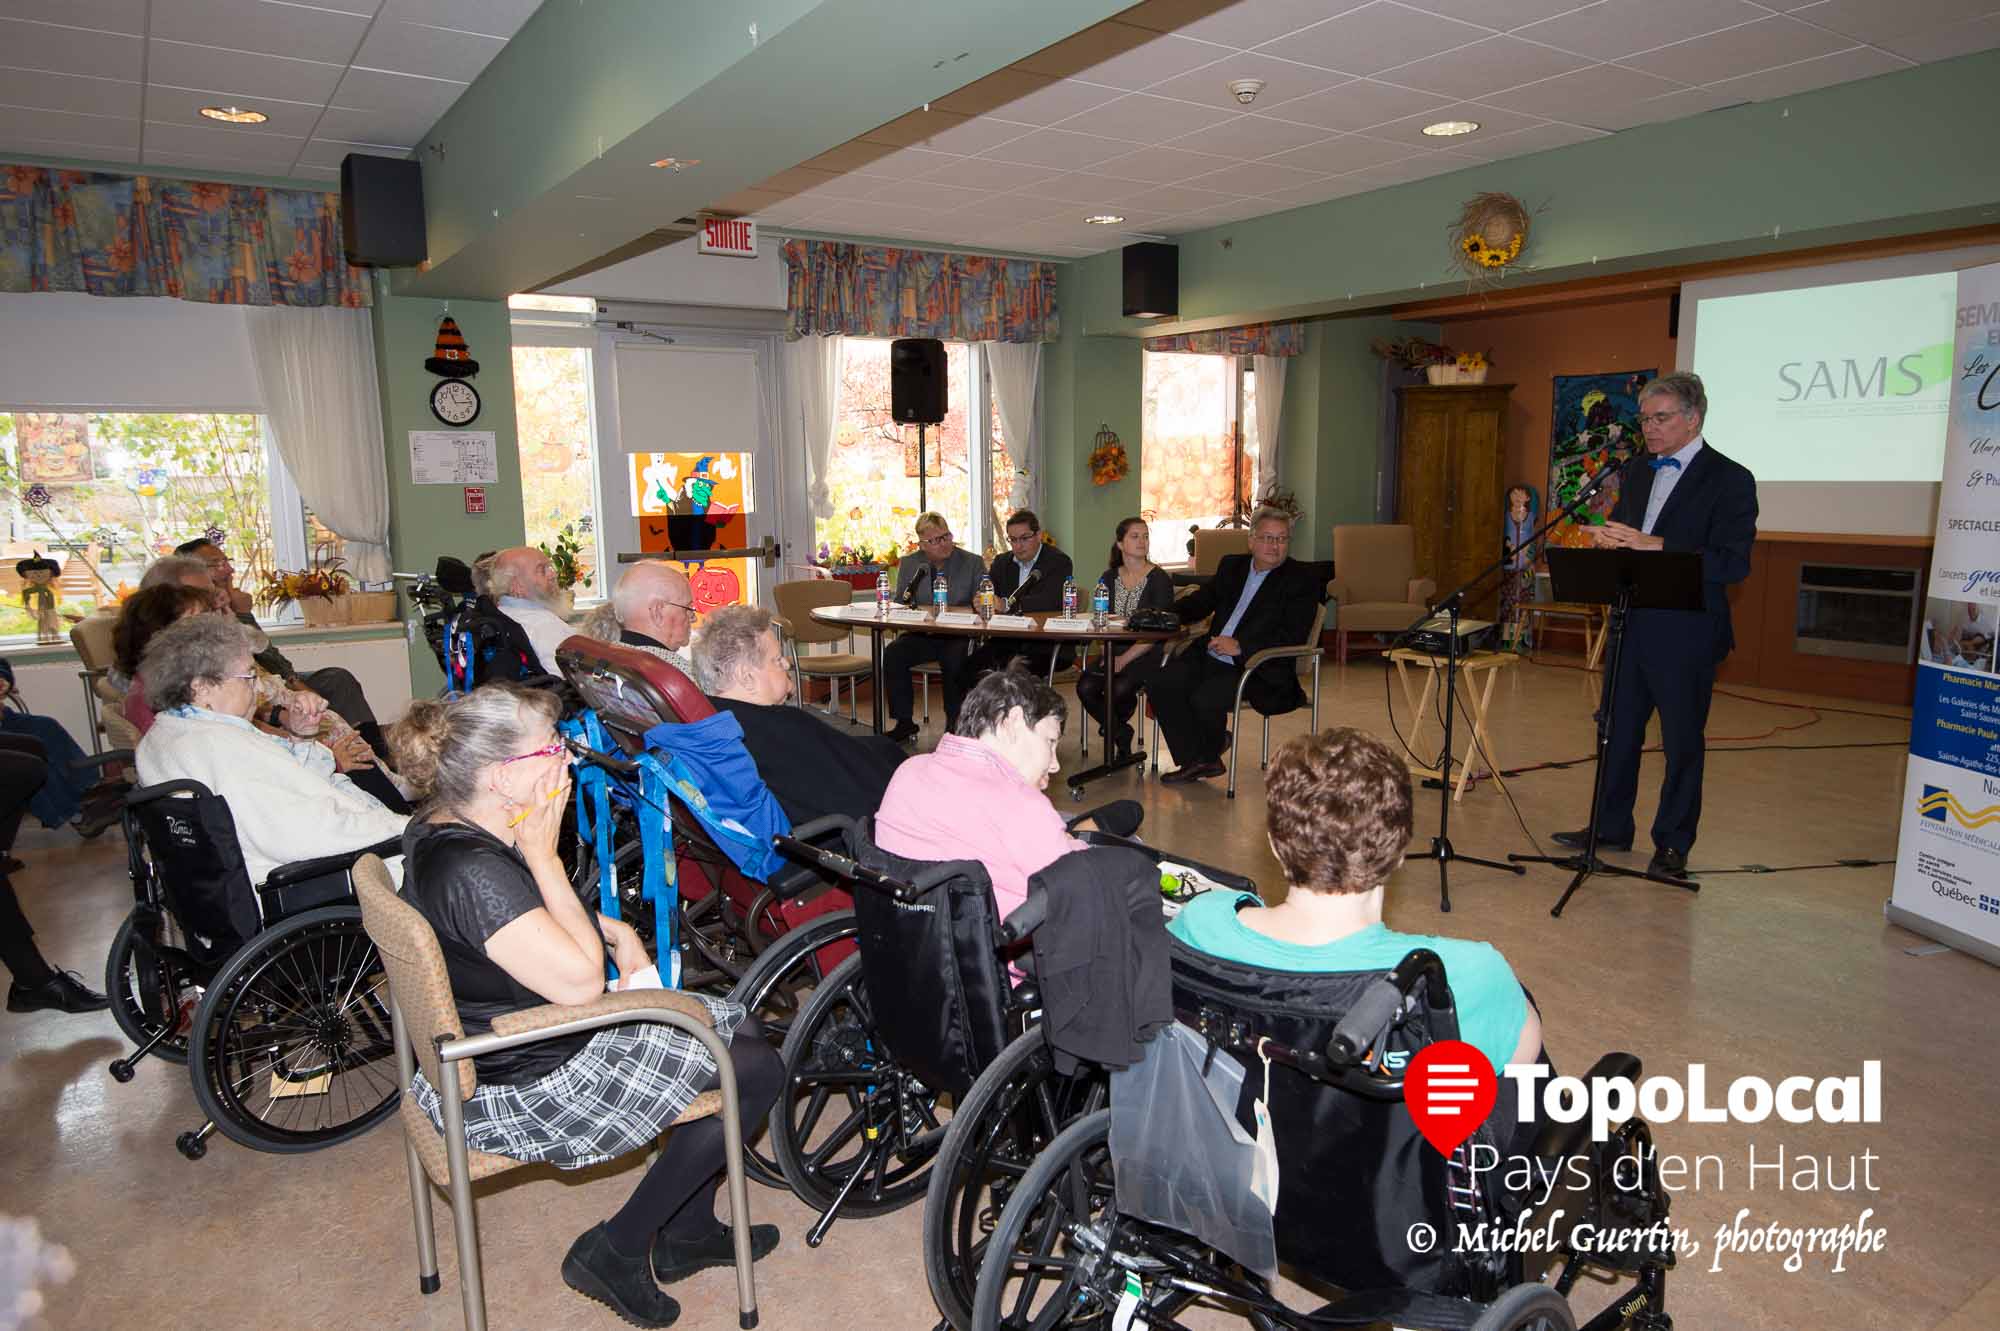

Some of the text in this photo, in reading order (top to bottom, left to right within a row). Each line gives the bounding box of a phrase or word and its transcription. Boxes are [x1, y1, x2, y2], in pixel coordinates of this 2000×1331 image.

[1956, 302, 2000, 328] SEM
[1777, 353, 1924, 402] SAMS
[1942, 672, 1982, 688] Pharmacie
[1938, 695, 1949, 704] Les
[1979, 702, 1991, 712] des
[1936, 718, 1998, 741] Pharmacie Paule
[1931, 880, 1977, 907] Québec
